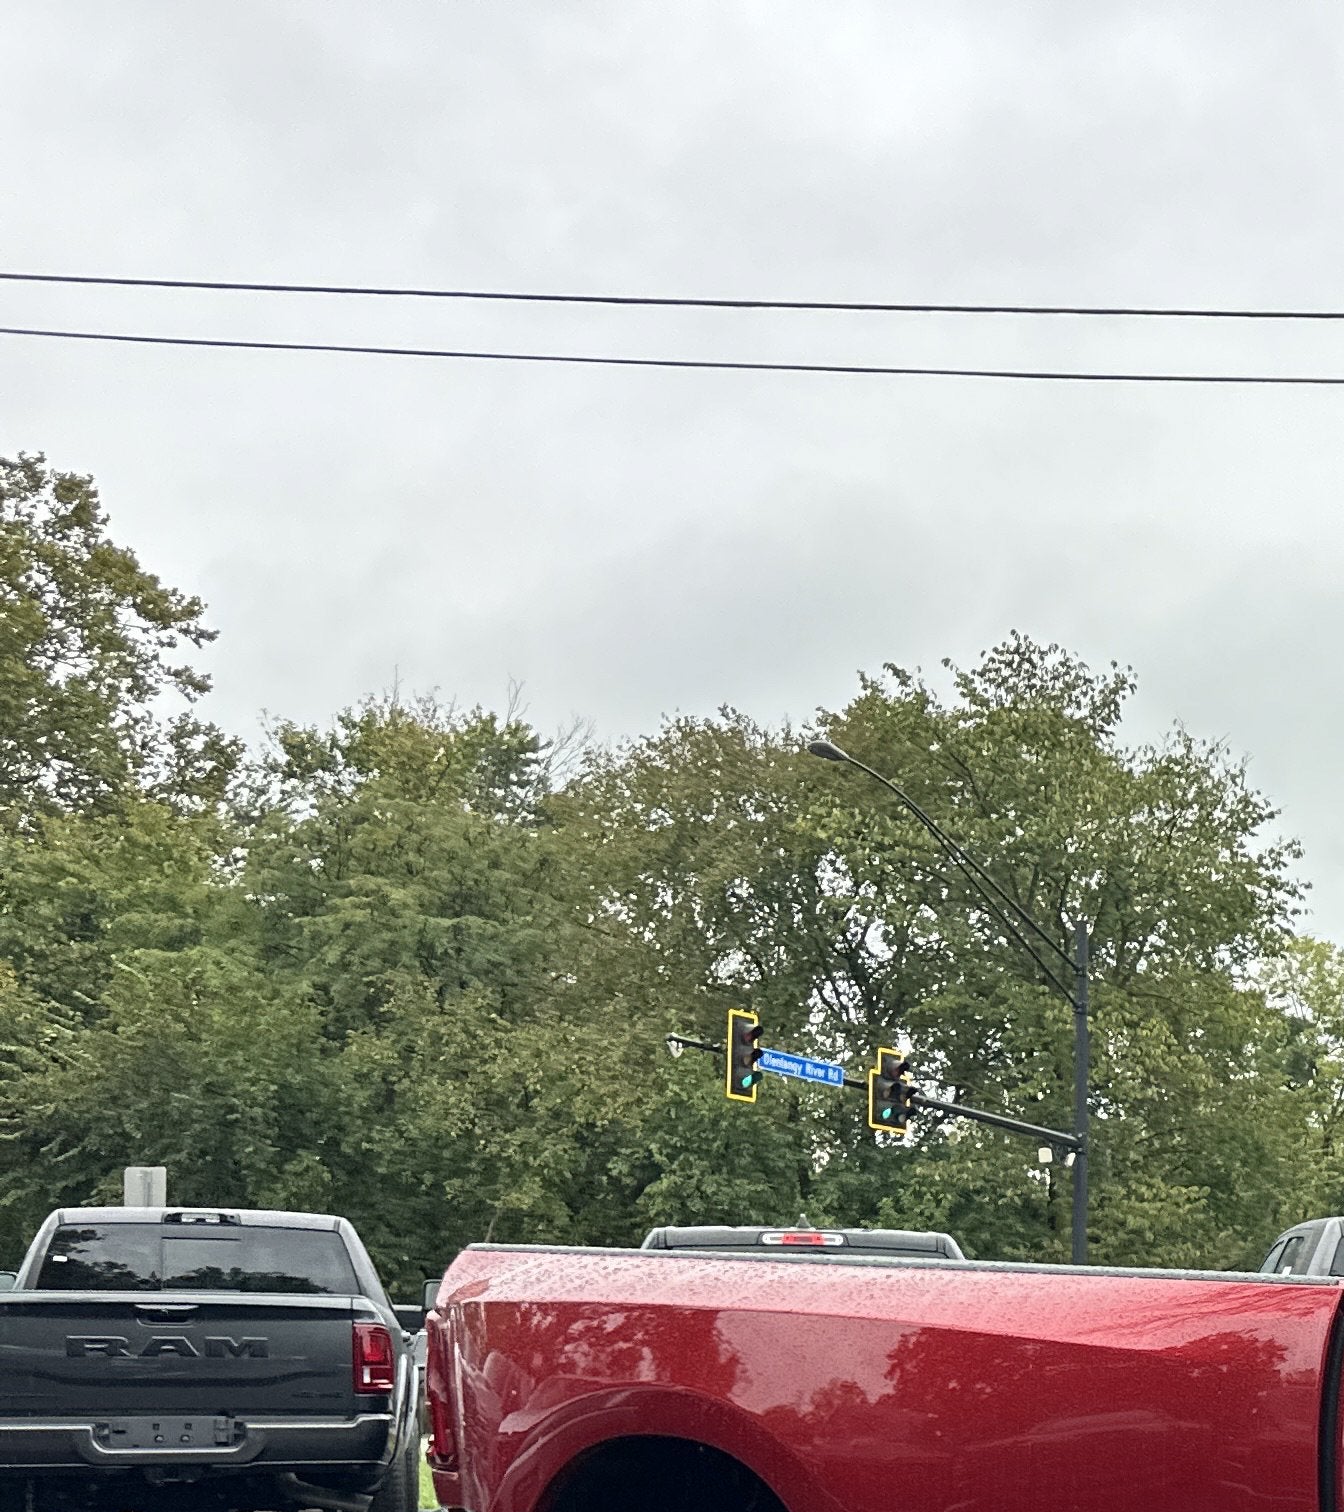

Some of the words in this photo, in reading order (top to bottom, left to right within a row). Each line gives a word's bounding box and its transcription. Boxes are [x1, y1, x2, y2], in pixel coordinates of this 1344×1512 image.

[805, 1062, 826, 1078] River
[827, 1068, 839, 1081] Rd
[66, 1335, 270, 1358] RAM
